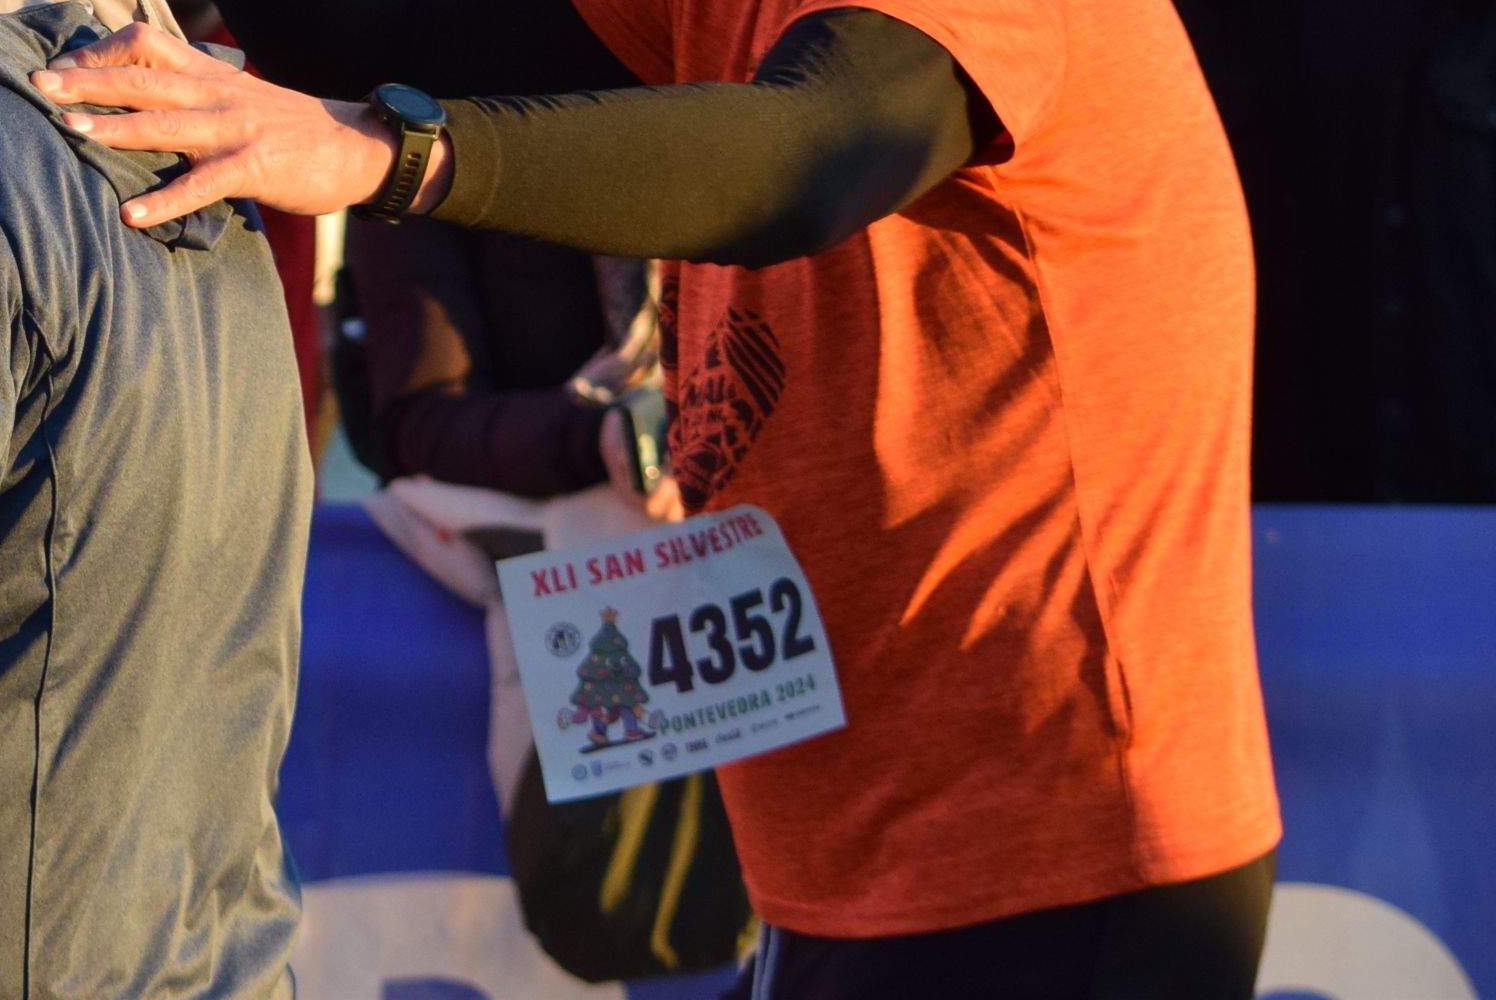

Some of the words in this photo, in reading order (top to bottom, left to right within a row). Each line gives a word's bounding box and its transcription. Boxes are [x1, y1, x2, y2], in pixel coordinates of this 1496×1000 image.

[530, 566, 577, 597] XLI
[587, 549, 645, 586] SAN
[655, 512, 764, 569] SILVESTRE
[647, 577, 815, 693] 4352
[660, 689, 772, 735] PONTEVEDRA
[777, 673, 818, 702] 2024
